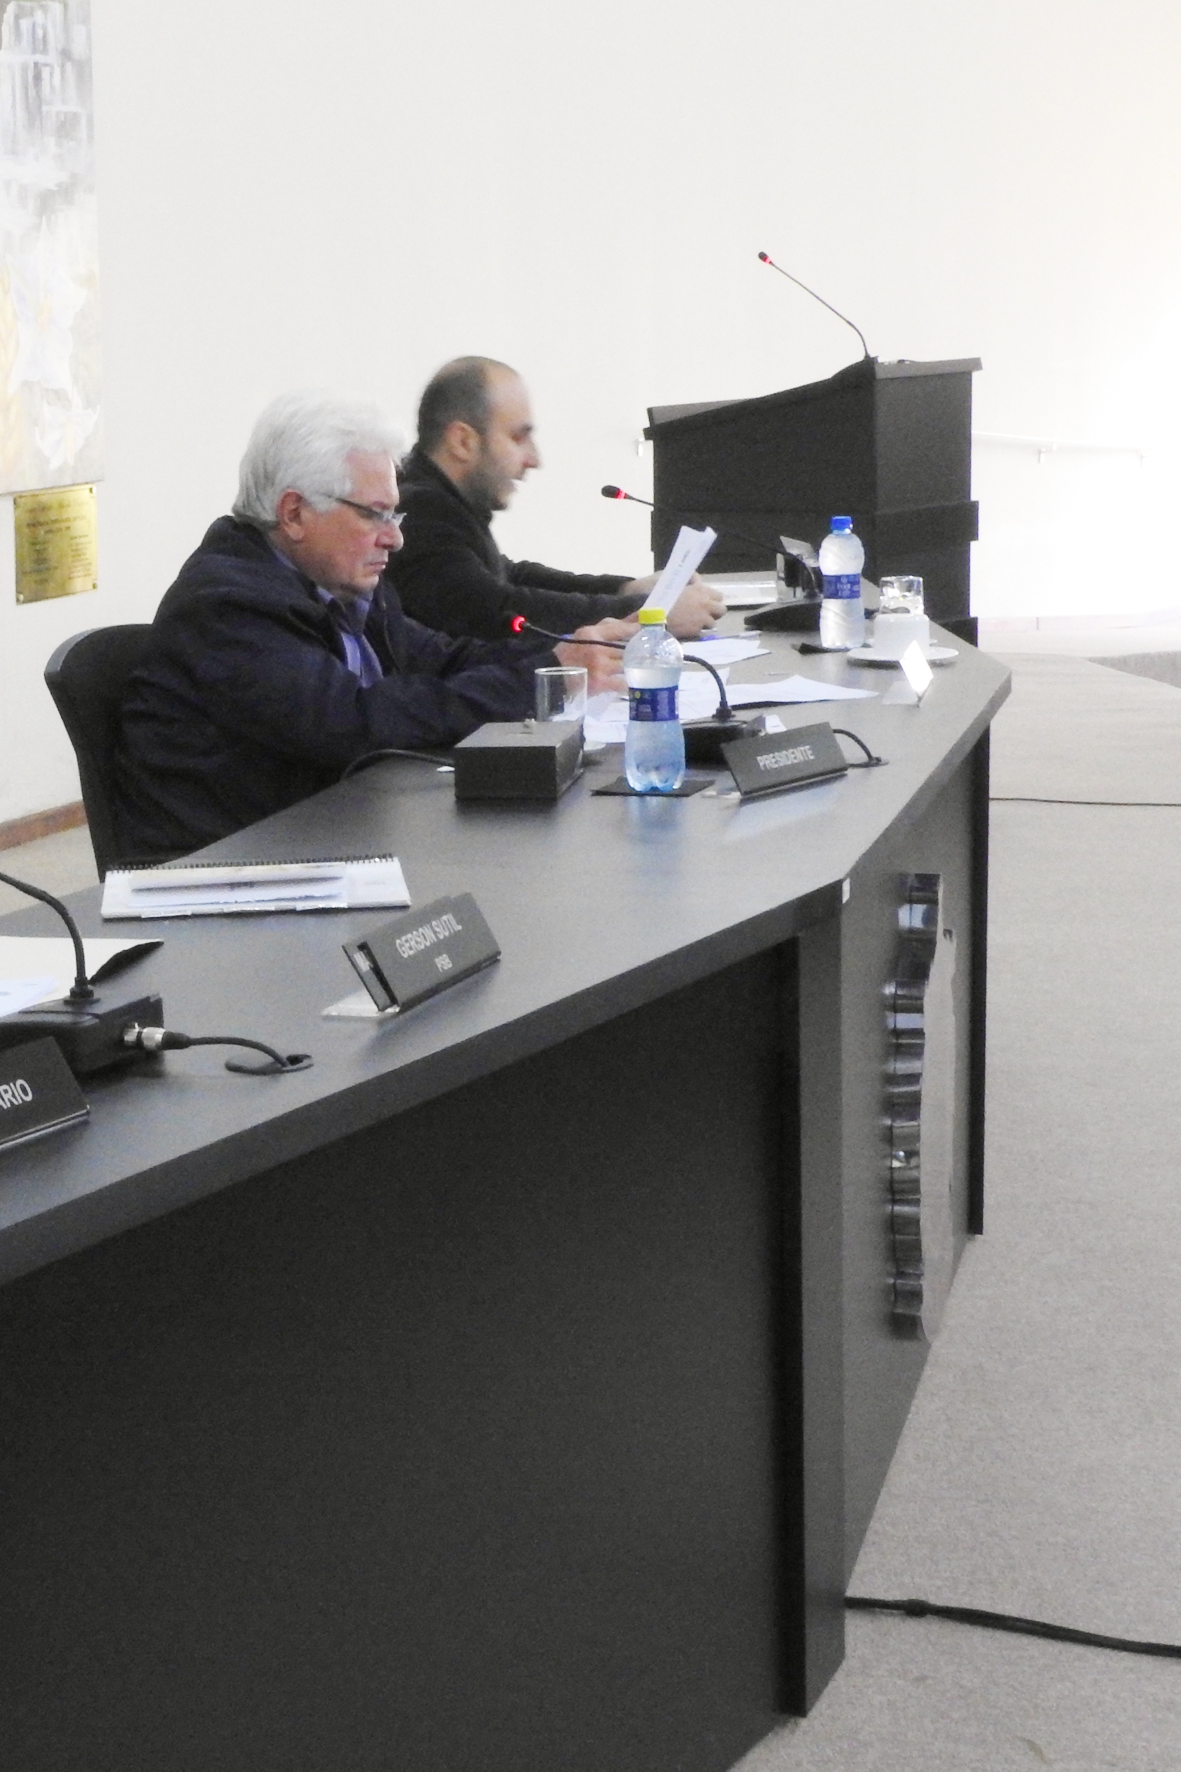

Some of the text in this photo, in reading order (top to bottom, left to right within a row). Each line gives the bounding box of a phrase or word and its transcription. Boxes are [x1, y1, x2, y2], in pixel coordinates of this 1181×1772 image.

[756, 745, 814, 771] PRESIDENTE
[395, 913, 462, 958] GERSON SUTIL
